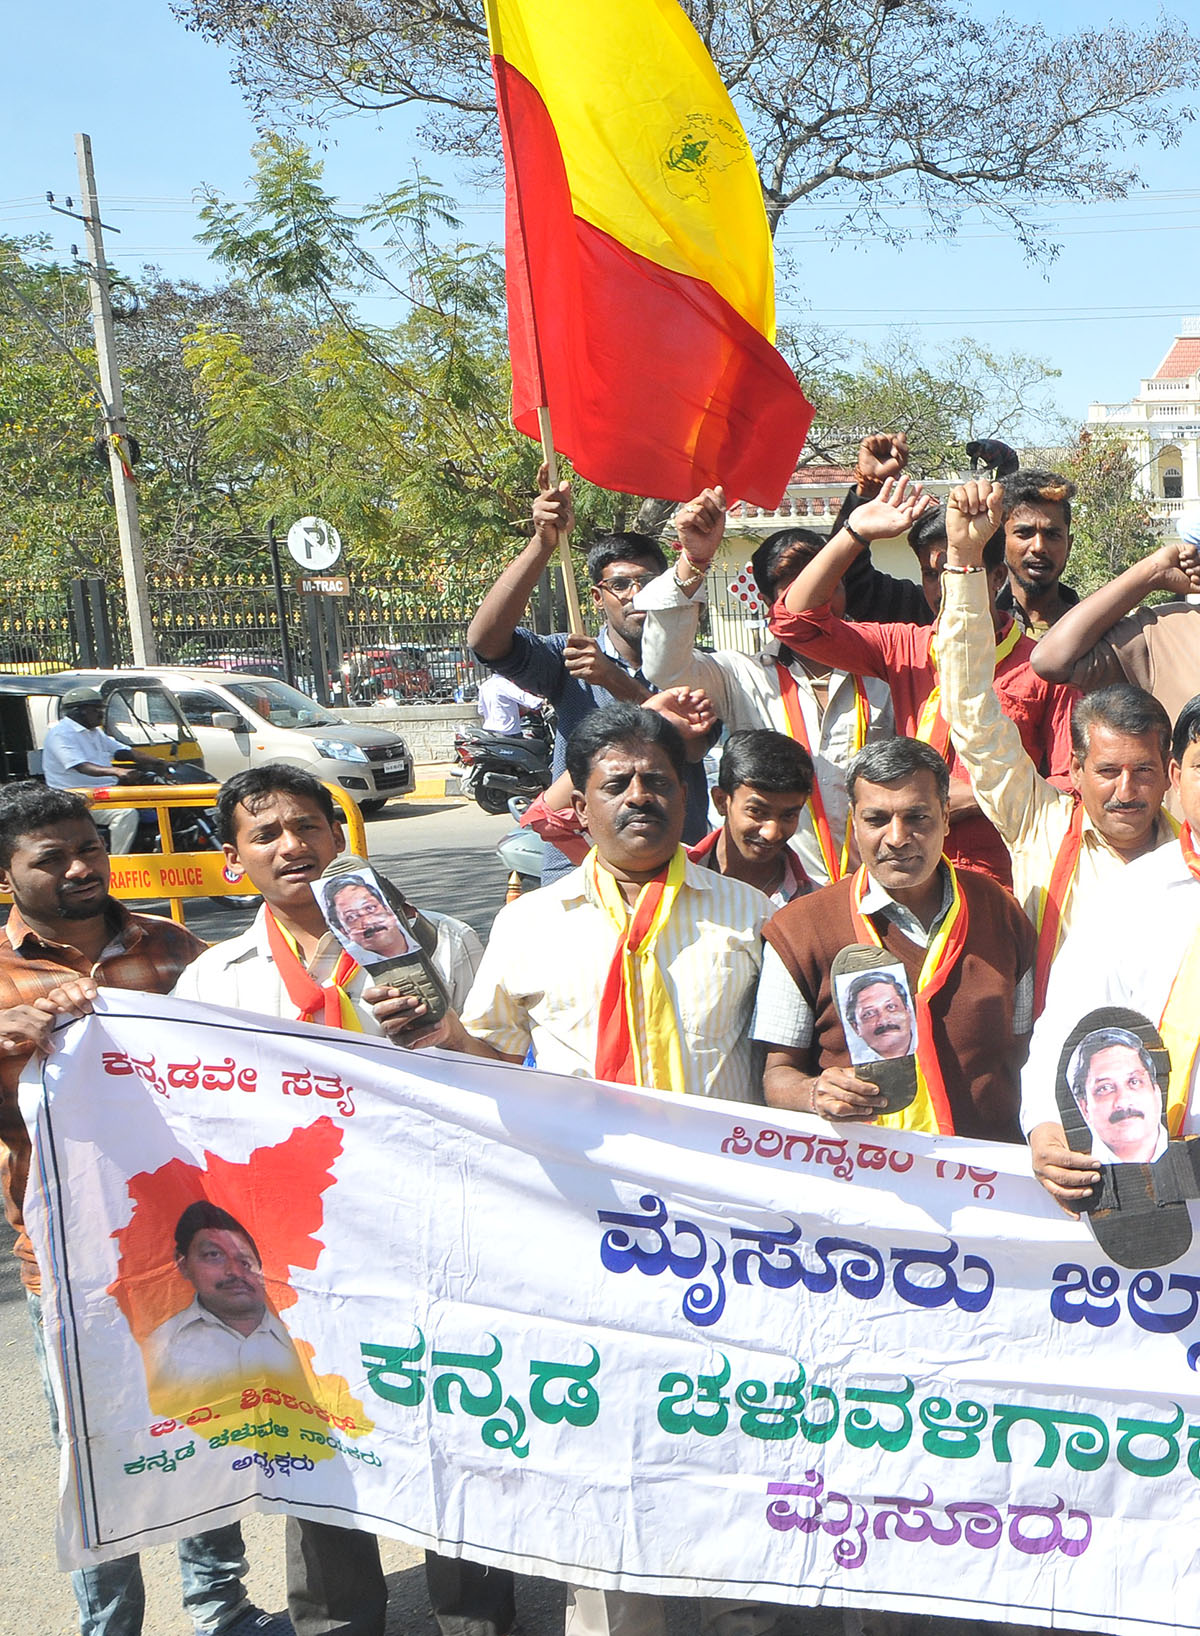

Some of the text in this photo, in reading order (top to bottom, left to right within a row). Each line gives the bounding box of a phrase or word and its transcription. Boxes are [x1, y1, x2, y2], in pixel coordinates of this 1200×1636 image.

[302, 580, 344, 593] M-TRAC
[110, 867, 203, 888] RAFFIC POLICE
[102, 1050, 356, 1117] ಕನ್ನಡವೇ ಸತ್ಯ
[720, 1126, 914, 1181] ಸಿರಿಗನ್ನಡಂ
[597, 1194, 995, 1326] ಮೈಸೂರು
[359, 1326, 601, 1458] ಕನ್ನಡ
[123, 1418, 382, 1476] ಕನ್ನಡ ಚಳುವಳಿ ನಾಯಕರು
[232, 1452, 315, 1479] ಅಧ್ಯಕ್ಷರು
[766, 1470, 1092, 1569] ಮೈಸೂರು
